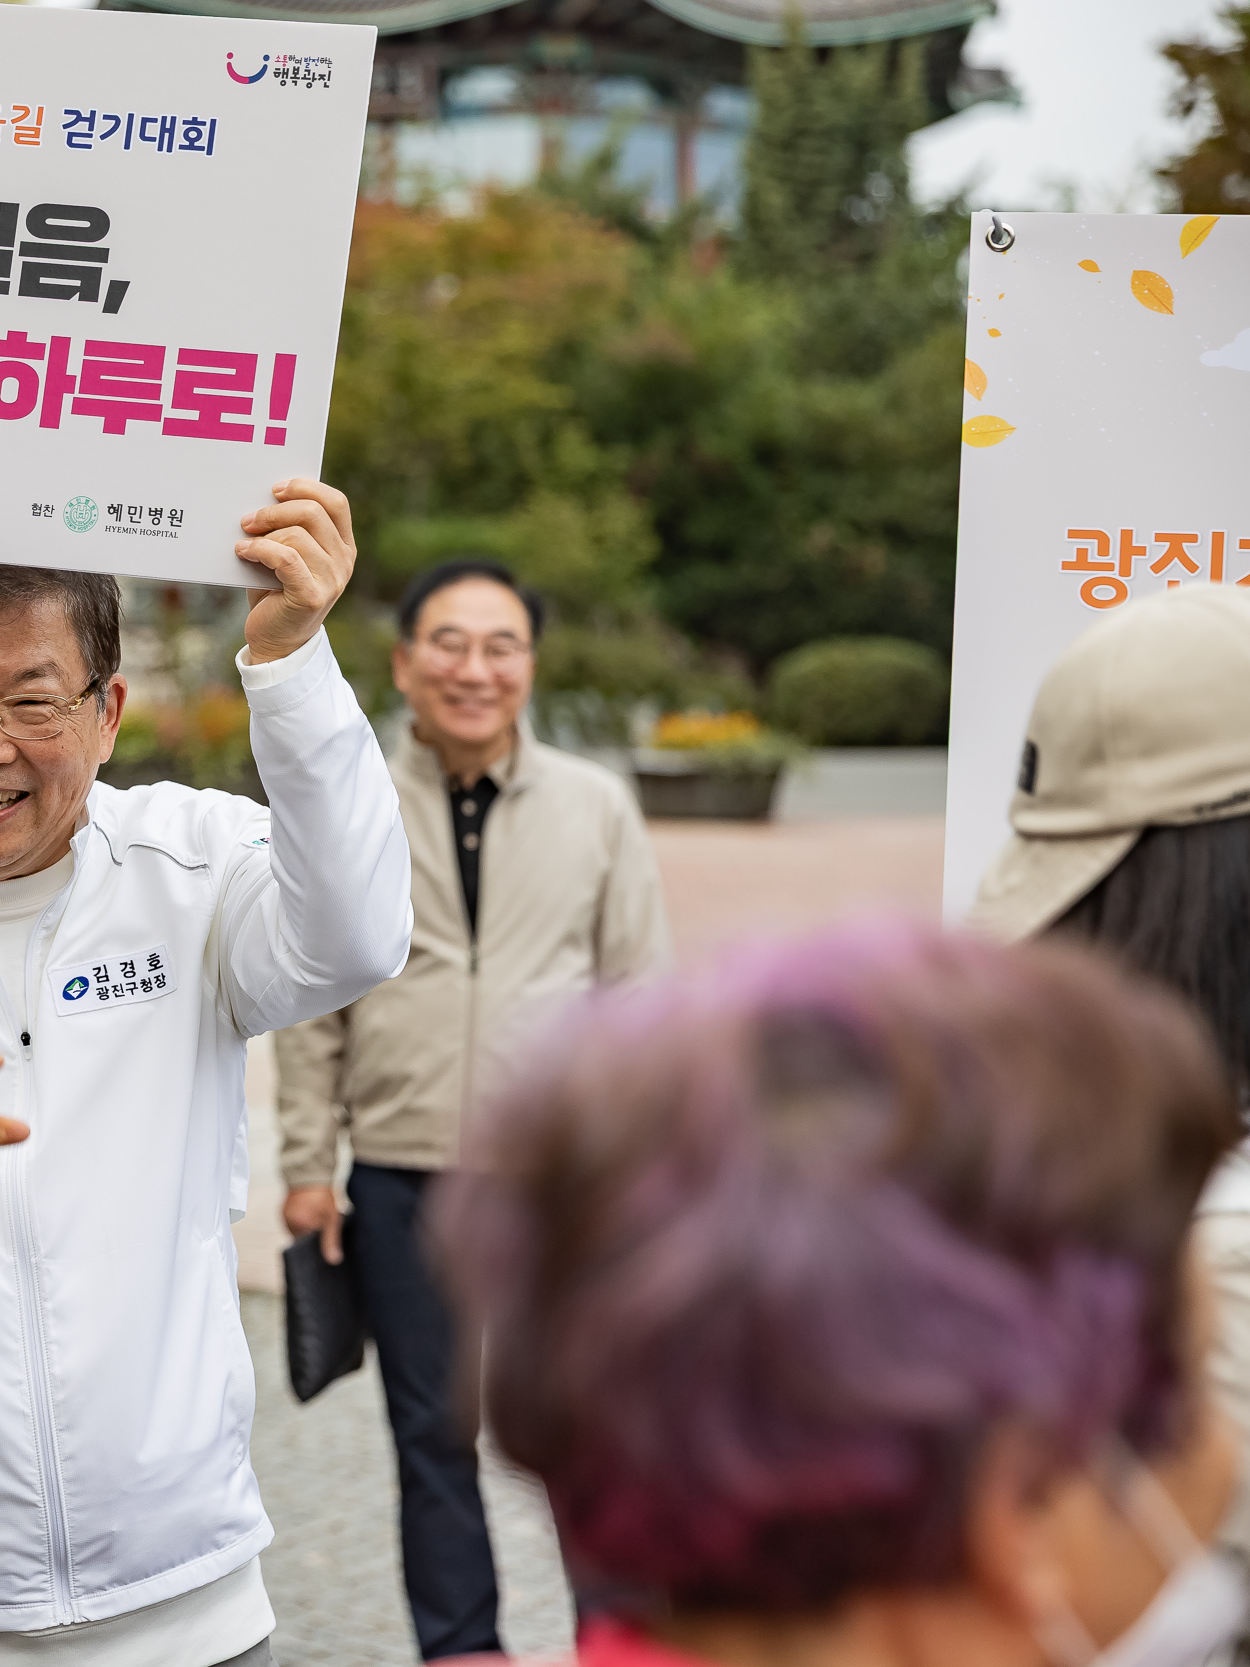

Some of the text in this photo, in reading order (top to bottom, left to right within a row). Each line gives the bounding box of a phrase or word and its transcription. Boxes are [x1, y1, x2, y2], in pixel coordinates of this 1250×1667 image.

[274, 54, 333, 69] 소통하며 발전하는
[273, 66, 332, 89] 행복광진
[61, 108, 218, 156] 걷기대회
[31, 502, 56, 518] 협찬
[107, 503, 184, 528] 혜민병원
[105, 525, 179, 539] HYEMIN HOSPITAL
[1061, 528, 1250, 609] 광진
[95, 972, 167, 1001] 광진구청장
